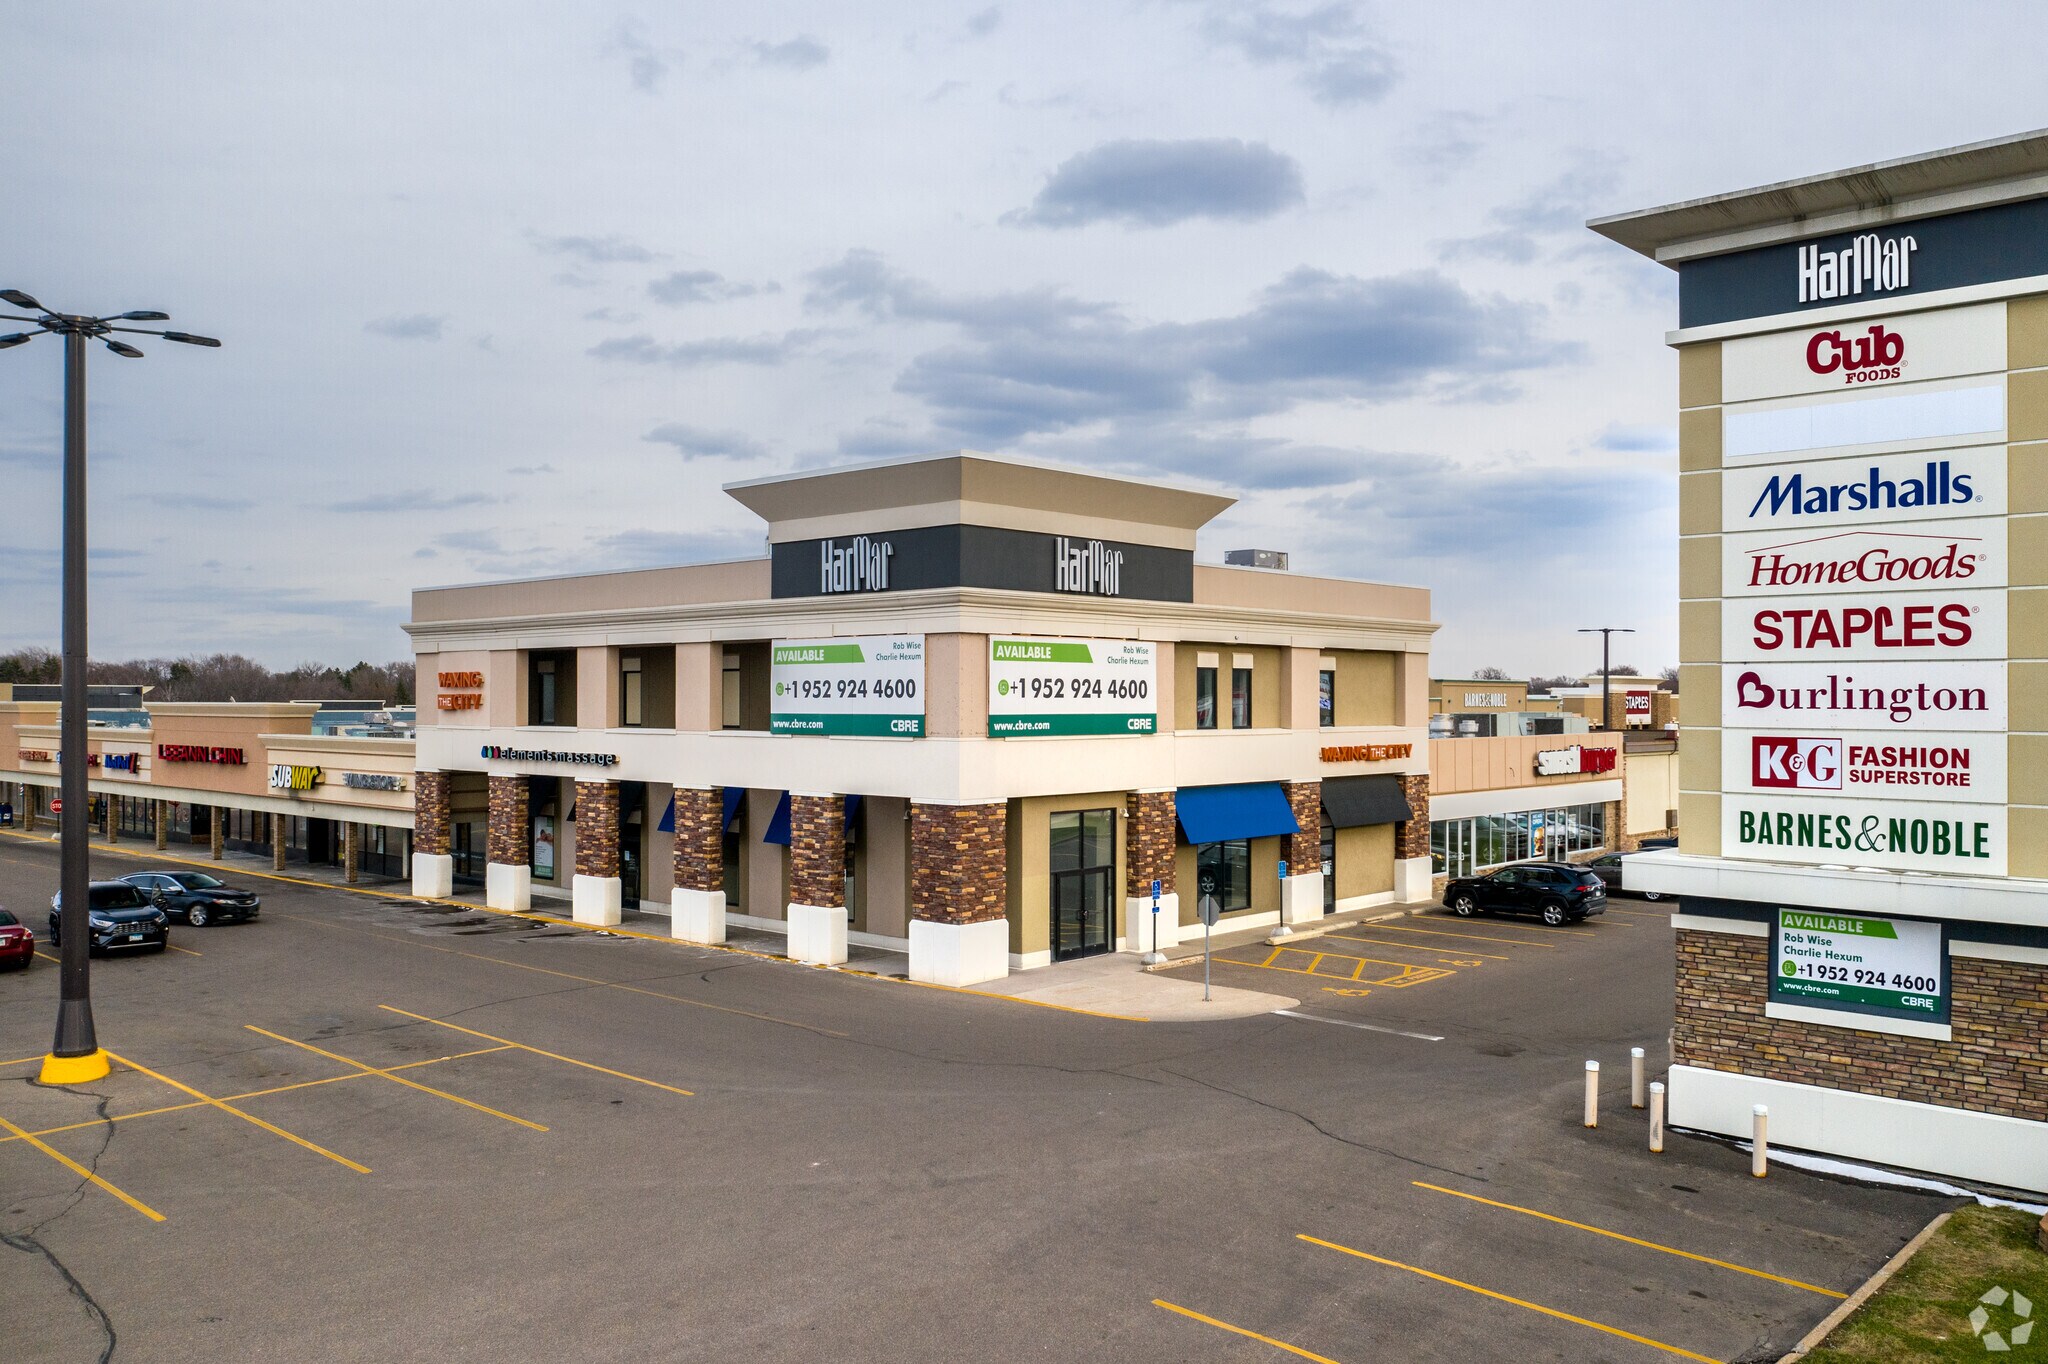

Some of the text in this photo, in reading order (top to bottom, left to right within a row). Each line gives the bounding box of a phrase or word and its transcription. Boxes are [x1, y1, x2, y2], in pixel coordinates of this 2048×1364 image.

[1798, 233, 1918, 303] HarMar
[1806, 325, 1905, 375] Cub
[1845, 366, 1901, 384] FOODS
[1749, 461, 1974, 518] Marshalls
[821, 535, 894, 593] HarMar
[1054, 537, 1124, 596] HarMar
[1747, 544, 1977, 587] HomeGoods
[1753, 603, 1973, 650] STAPLES
[893, 641, 921, 650] Rob Wise
[996, 645, 1052, 659] AVAILABLE
[1123, 646, 1149, 655] Rob Wise
[776, 648, 825, 662] AVAILABLE
[876, 652, 921, 661] Charlie Hexum
[1107, 656, 1149, 665] Charlie Hexum
[438, 671, 483, 688] WAXING
[785, 678, 916, 699] +1 952 924 4600
[1010, 678, 1148, 699] +1 952 924 4600
[438, 693, 482, 709] THE CITY
[1626, 696, 1649, 709] STAPLES
[1737, 671, 1989, 723] Burlington
[773, 719, 823, 731] www.cbre.com
[890, 720, 919, 733] CBRE
[994, 719, 1050, 732] www.cbre.com
[1127, 718, 1152, 730] CBRE
[158, 744, 243, 765] LEEANN CHIN
[500, 747, 614, 767] elements massage
[1321, 743, 1412, 762] WAXING THE CITY
[1849, 746, 1970, 770] FASHION
[1759, 744, 1837, 782] K&G
[270, 764, 321, 790] SUBWAY
[1849, 769, 1971, 787] SUPERSTORE
[1739, 810, 1990, 858] BARNES&NOBLE
[1784, 914, 1864, 933] AVAILABLE
[1784, 933, 1833, 947] Rob Wise
[1784, 945, 1863, 963] Charlie Hexum
[1797, 963, 1937, 993] +1 952 924 4600
[1783, 983, 1840, 996] www.cbre.com
[1901, 995, 1934, 1009] CBRE
